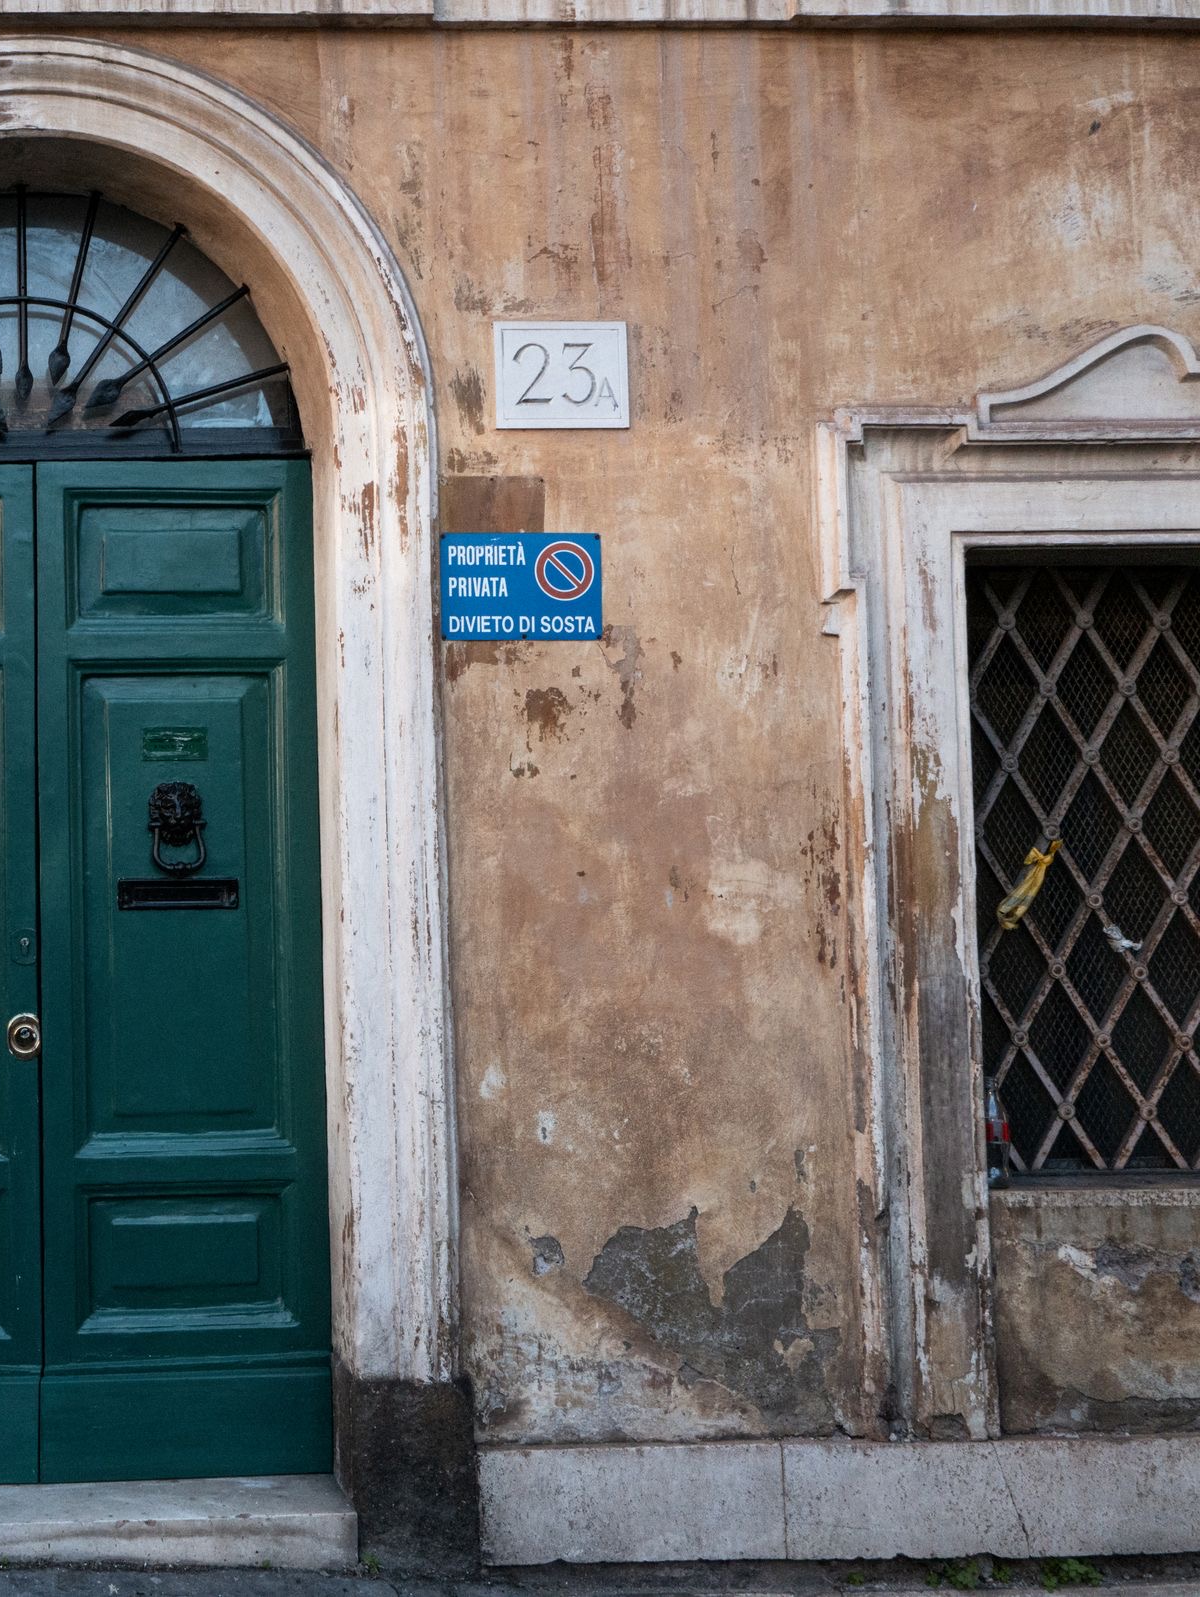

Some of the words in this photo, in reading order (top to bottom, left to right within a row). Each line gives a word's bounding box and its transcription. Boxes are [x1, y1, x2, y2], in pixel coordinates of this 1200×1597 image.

[448, 541, 526, 566] PROPRIETÀ
[448, 577, 508, 597] PRIVATA
[449, 615, 515, 633] DIVIETO
[519, 615, 536, 633] DI
[540, 615, 596, 633] SOSTA
